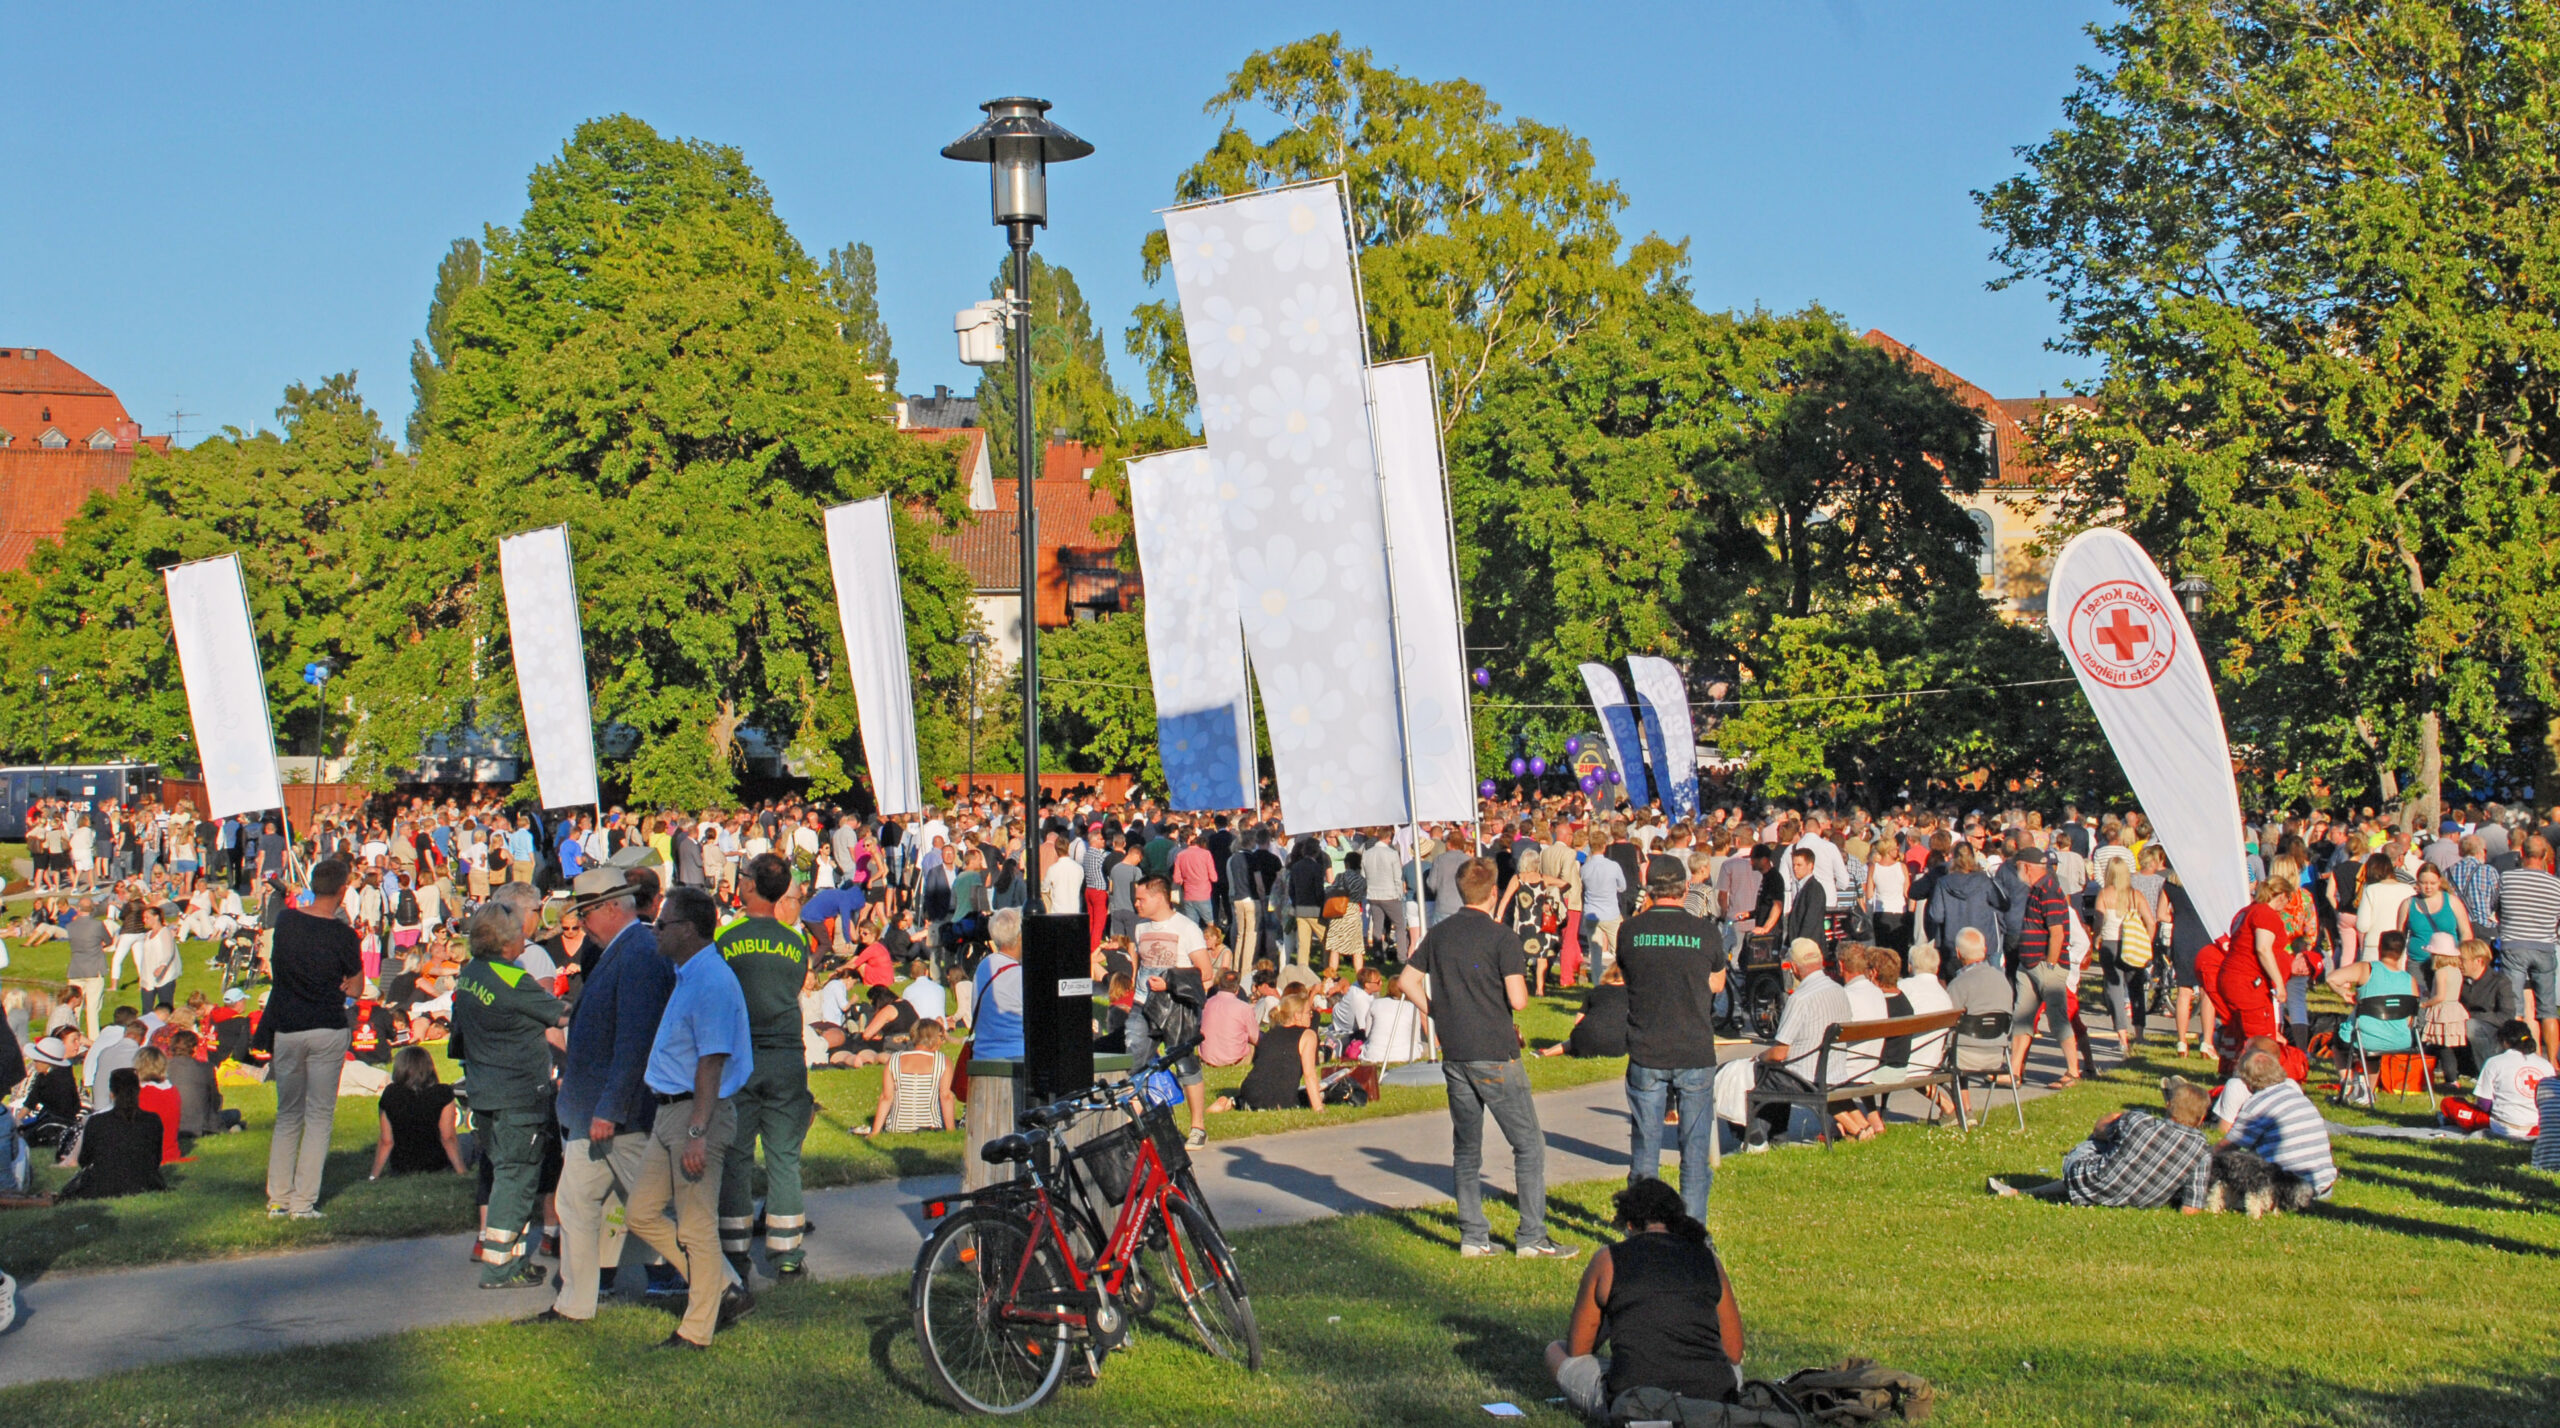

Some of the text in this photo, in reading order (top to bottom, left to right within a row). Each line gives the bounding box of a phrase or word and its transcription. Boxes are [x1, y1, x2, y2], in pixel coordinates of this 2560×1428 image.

[722, 938, 802, 963] AMBULANS
[1633, 933, 1701, 949] SÖDERMALM
[1126, 1198, 1150, 1252] MONARK
